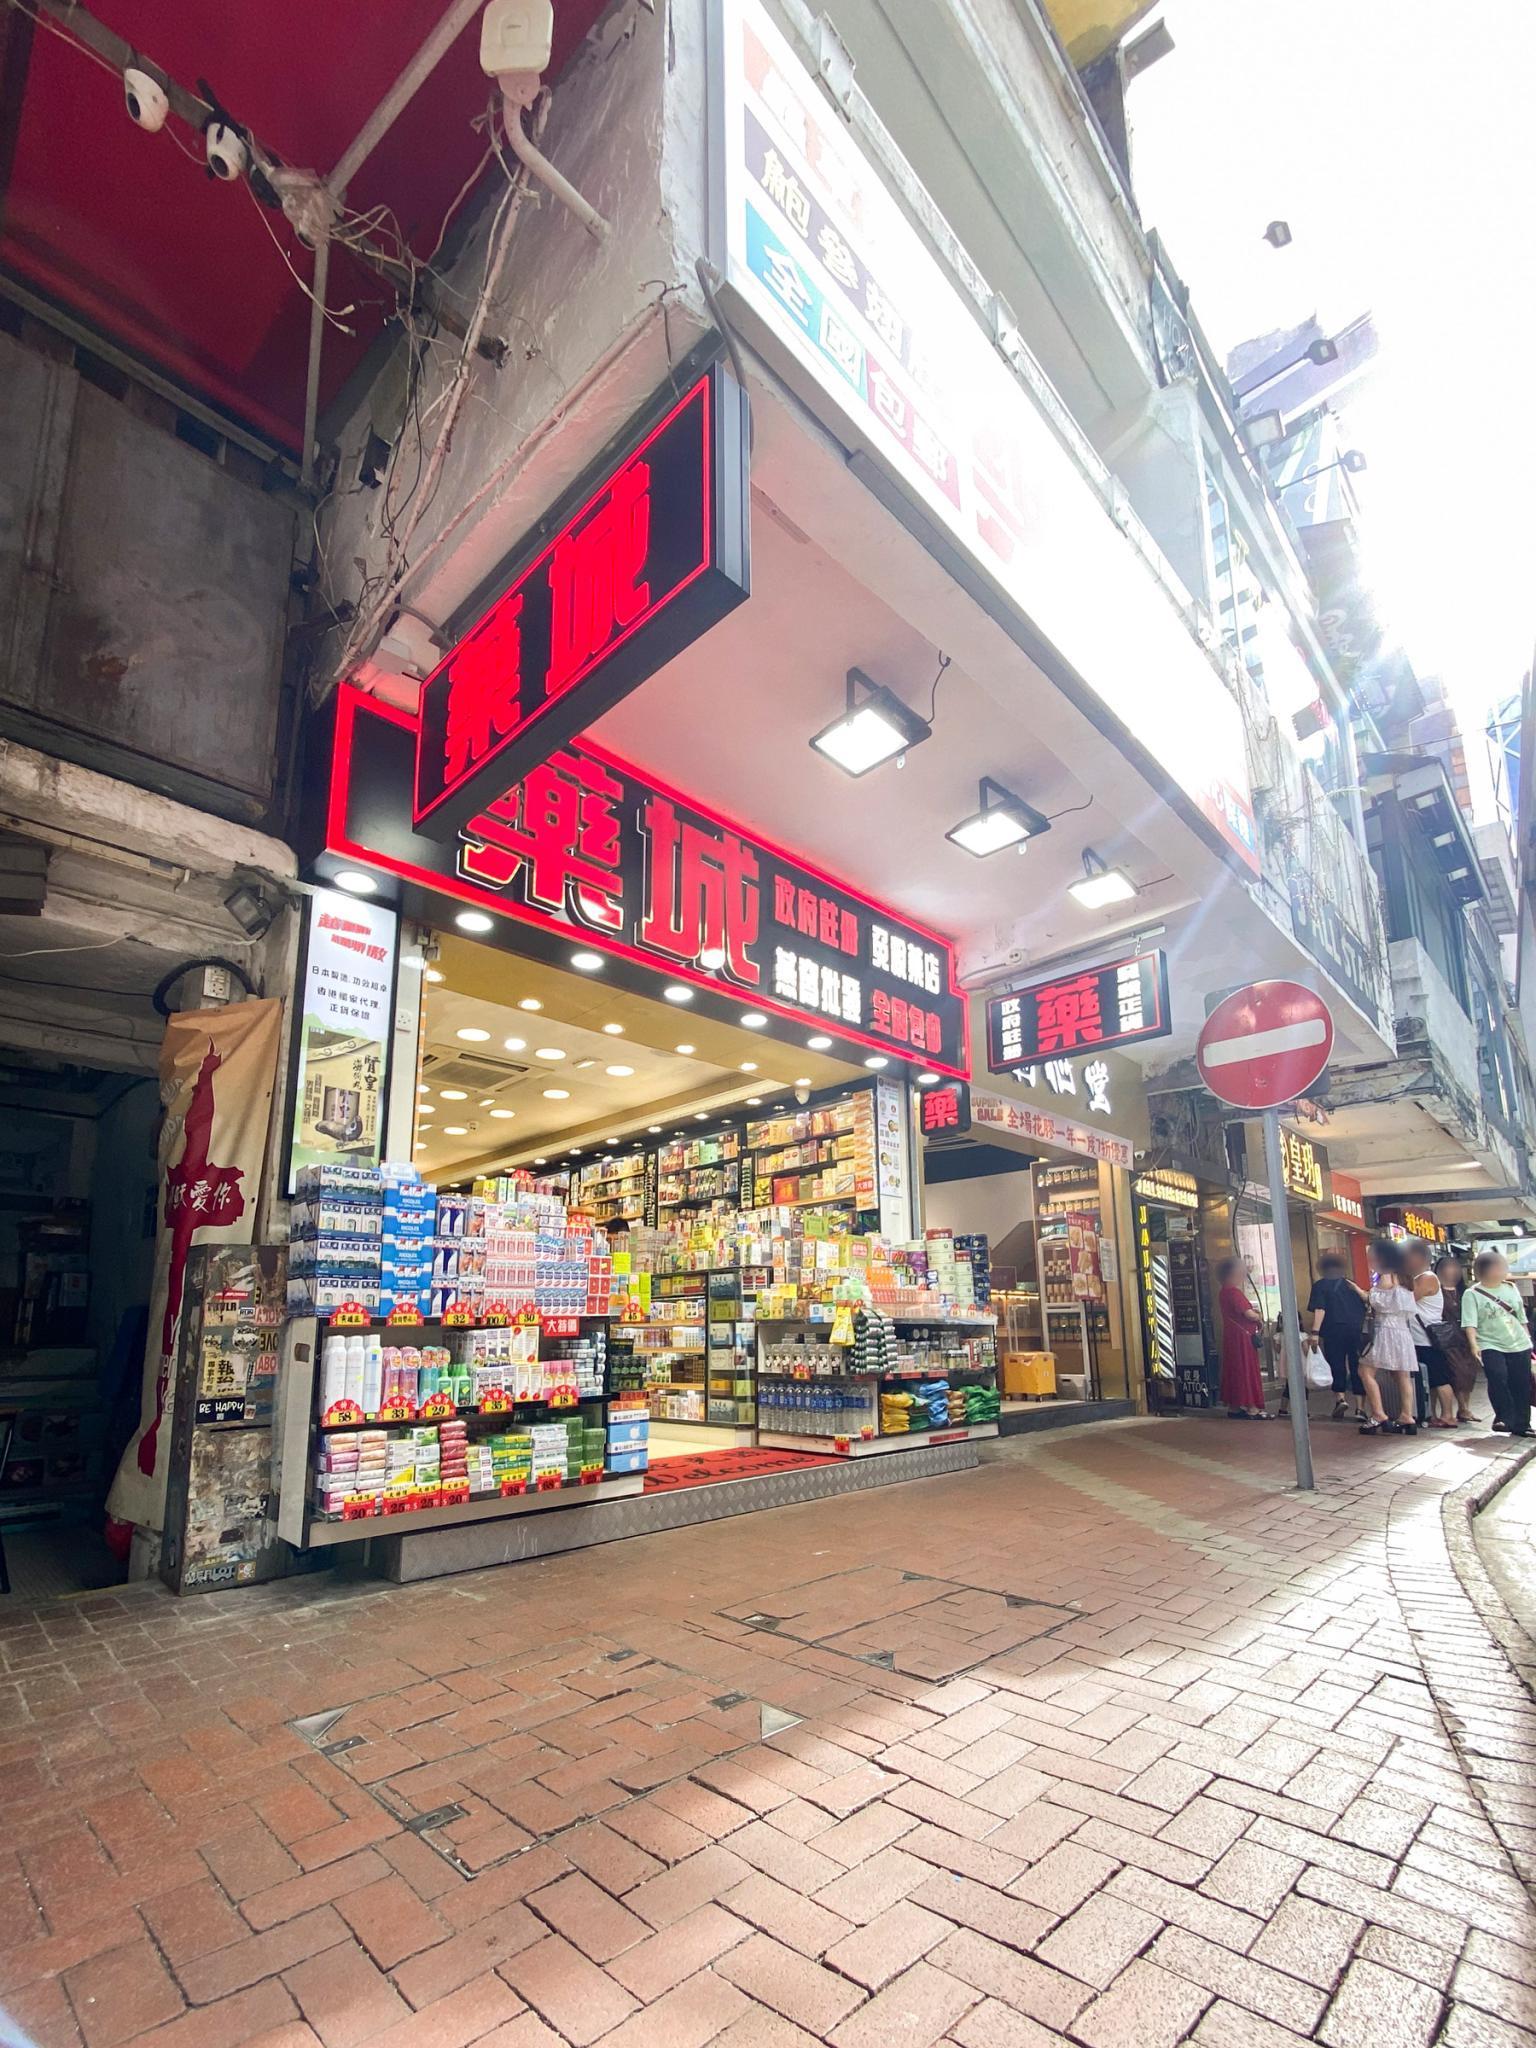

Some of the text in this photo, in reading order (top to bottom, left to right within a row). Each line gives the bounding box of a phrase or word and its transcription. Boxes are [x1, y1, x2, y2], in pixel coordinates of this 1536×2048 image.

[762, 148, 940, 395] 鮑參翅
[1035, 975, 1104, 1054] 藥
[923, 1087, 959, 1131] 藥
[453, 1314, 466, 1324] 32
[199, 1401, 245, 1414] BE HAPPY
[391, 1408, 404, 1419] 33
[431, 1405, 446, 1416] 29
[338, 1411, 352, 1423] 58
